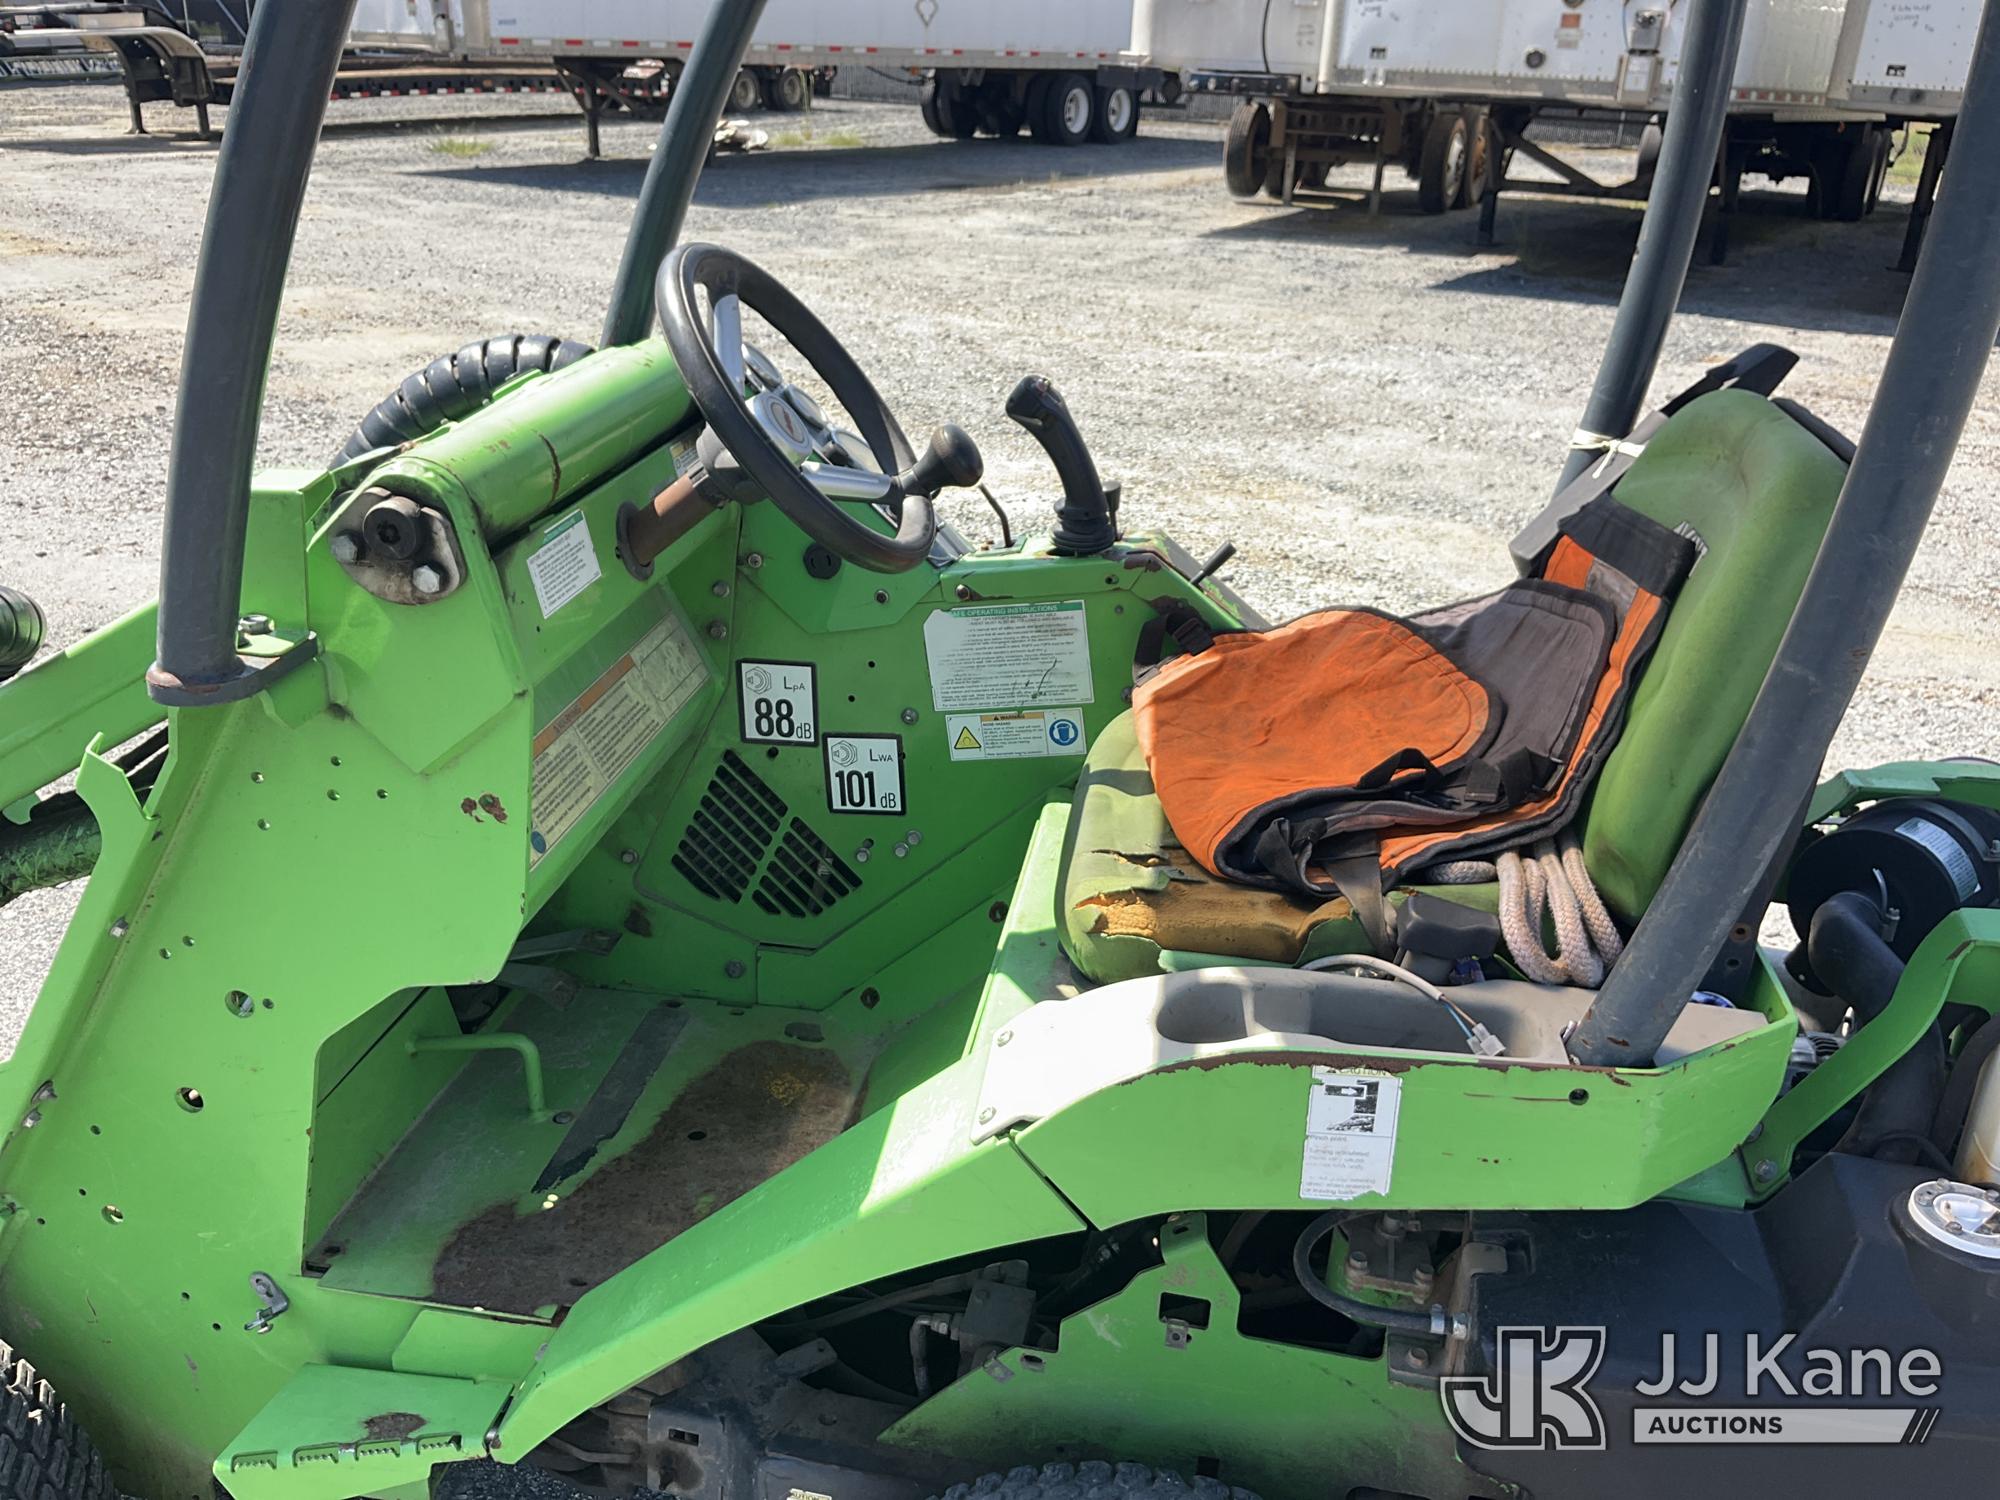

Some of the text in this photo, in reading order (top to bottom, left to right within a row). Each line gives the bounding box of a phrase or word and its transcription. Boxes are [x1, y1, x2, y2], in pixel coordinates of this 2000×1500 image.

[967, 607, 1007, 617] OPERATING
[1007, 604, 1058, 615] INSTRUCTIONS
[754, 697, 812, 739] 88 dB
[835, 769, 897, 809] 101 dB
